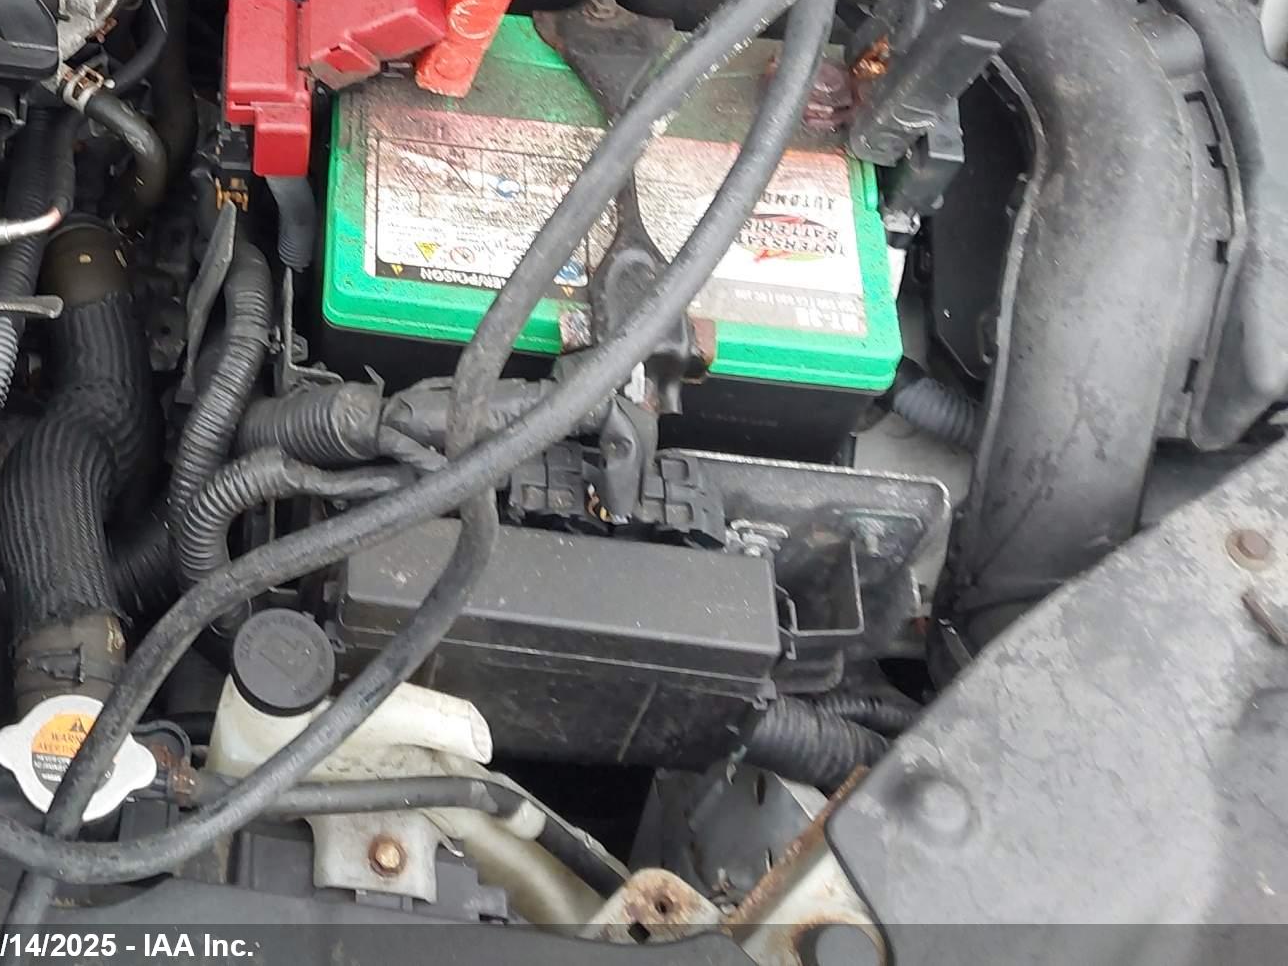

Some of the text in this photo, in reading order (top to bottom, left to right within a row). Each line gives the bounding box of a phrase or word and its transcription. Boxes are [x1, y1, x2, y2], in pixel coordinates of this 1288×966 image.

[761, 192, 835, 211] AUTOMO
[742, 219, 838, 242] BATTERIE
[734, 234, 848, 257] INTERSTAT
